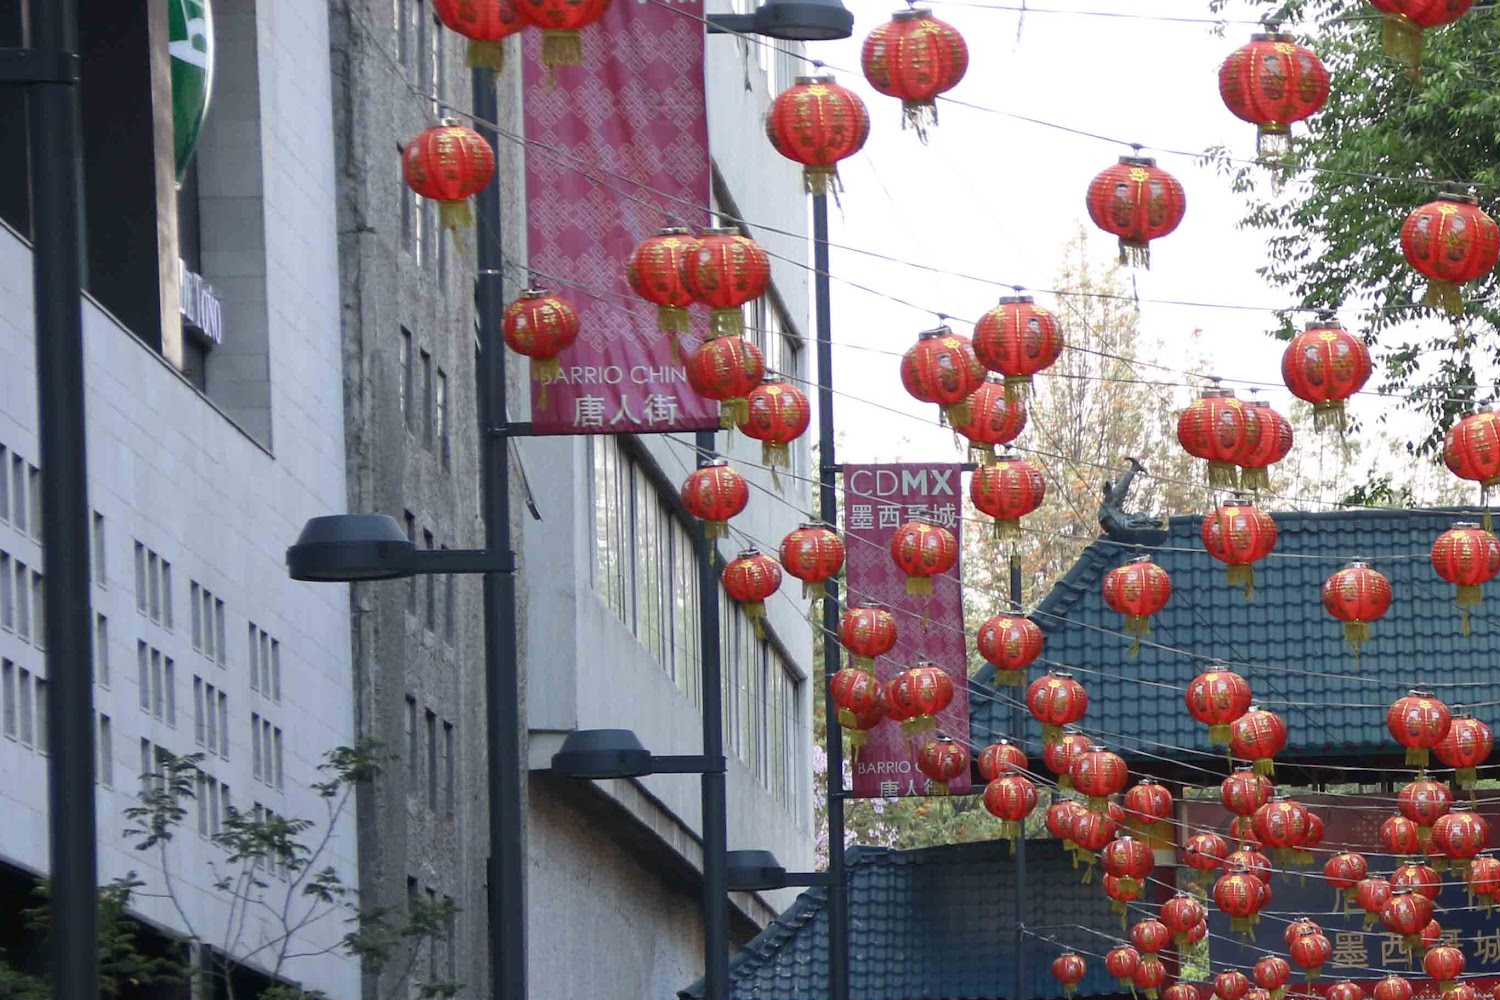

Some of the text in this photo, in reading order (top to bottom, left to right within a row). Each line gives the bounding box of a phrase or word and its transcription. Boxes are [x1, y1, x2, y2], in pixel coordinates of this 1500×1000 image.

[630, 365, 688, 385] CHIN
[573, 394, 678, 427] 唐人街
[850, 469, 954, 496] CDMX
[858, 760, 911, 774] BARRIO
